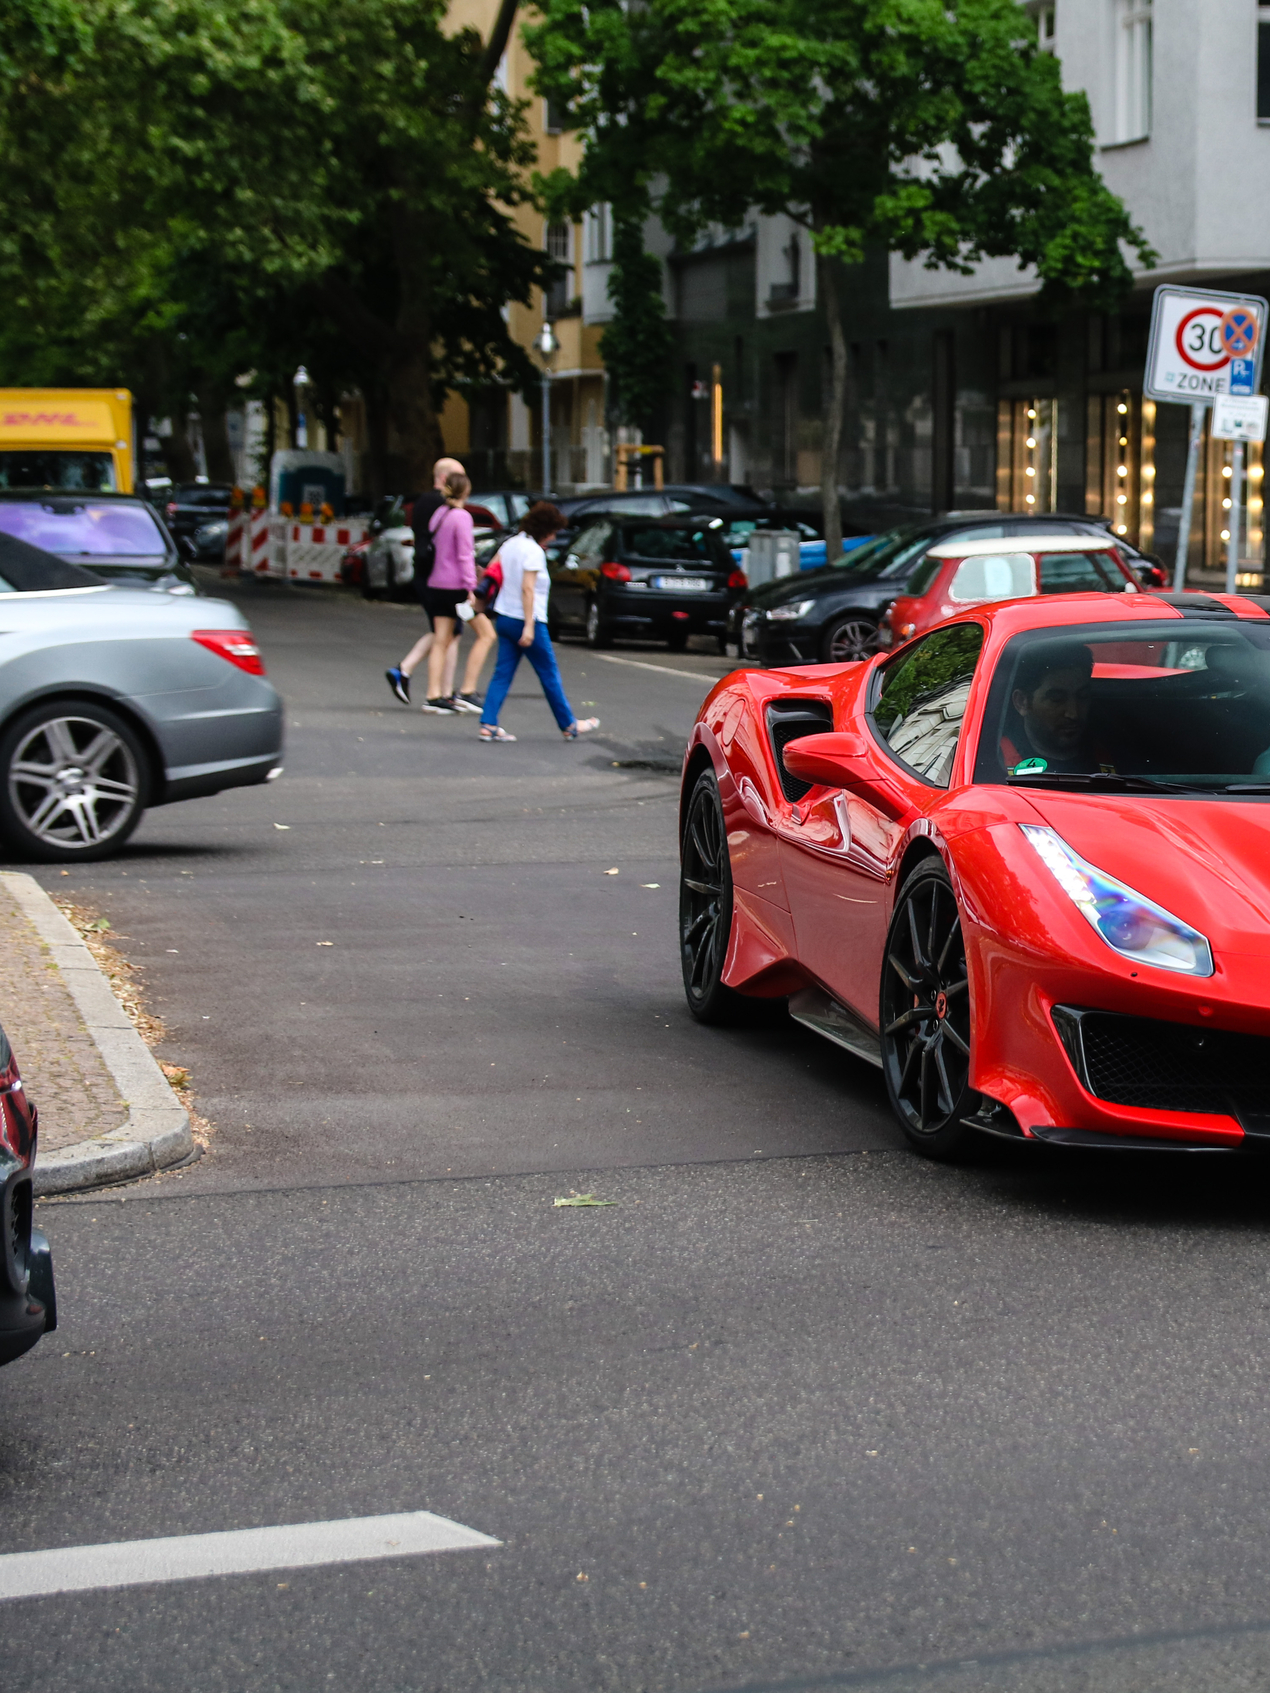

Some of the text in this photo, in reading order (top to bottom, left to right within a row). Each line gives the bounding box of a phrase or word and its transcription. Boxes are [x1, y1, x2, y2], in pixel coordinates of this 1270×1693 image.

[1188, 323, 1224, 354] 30
[1177, 372, 1226, 393] ZONE
[1026, 758, 1037, 768] 4
